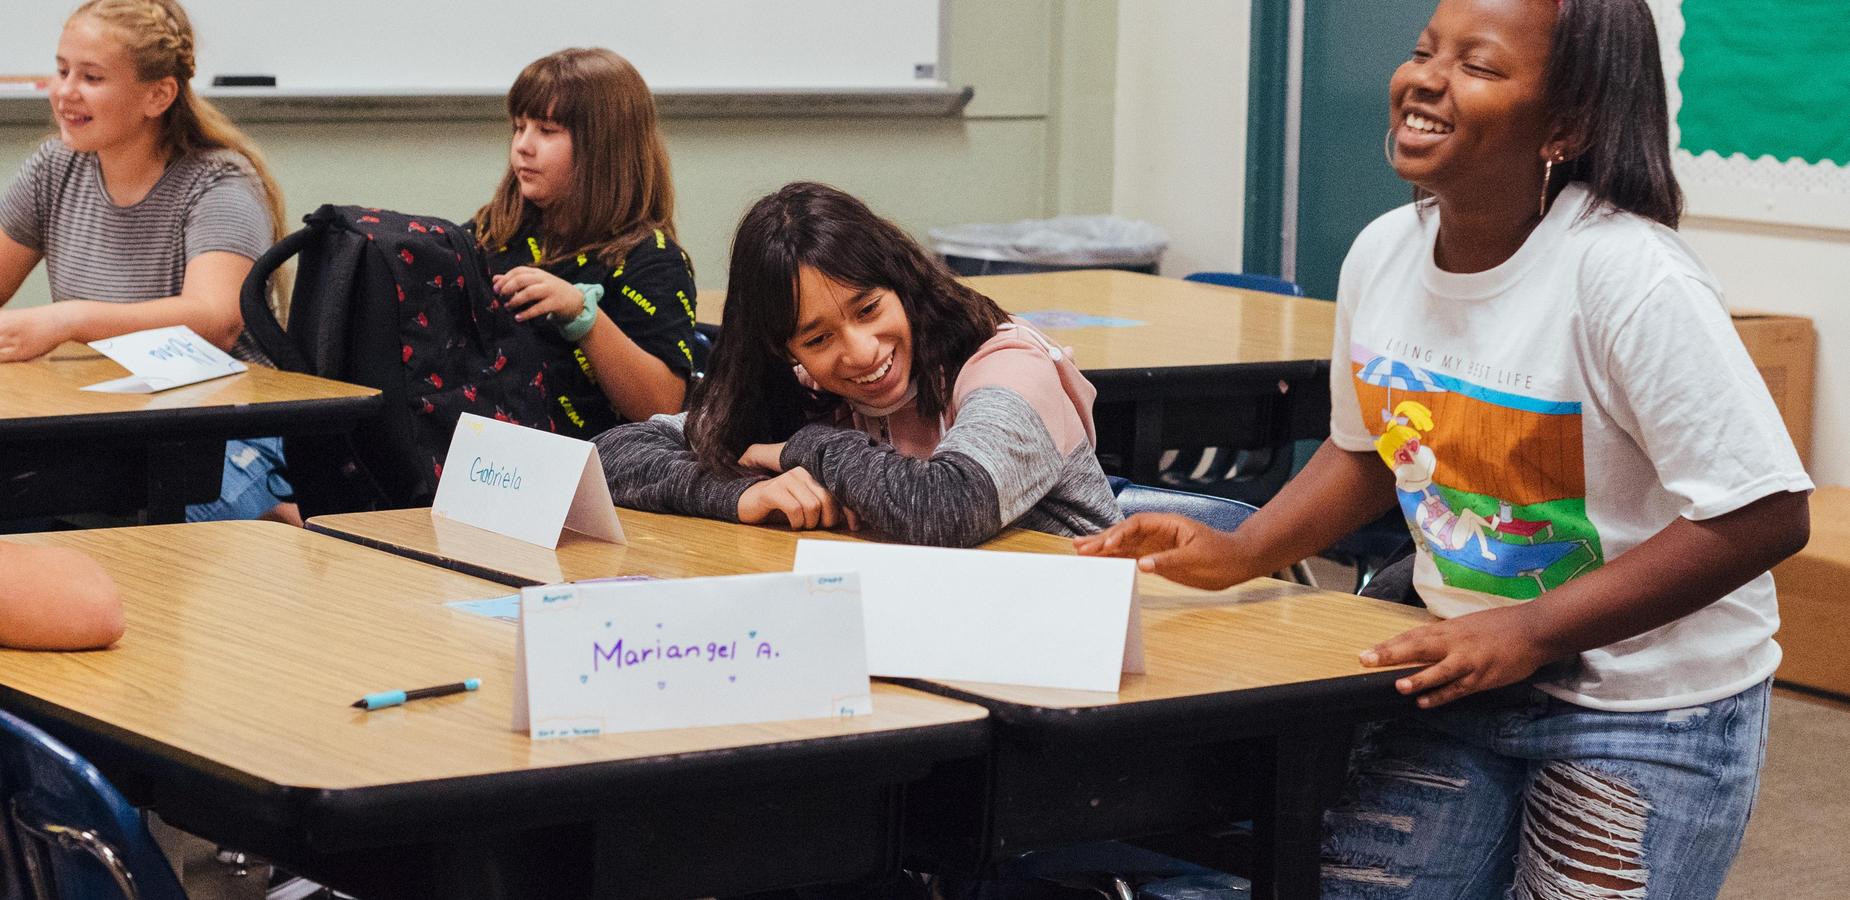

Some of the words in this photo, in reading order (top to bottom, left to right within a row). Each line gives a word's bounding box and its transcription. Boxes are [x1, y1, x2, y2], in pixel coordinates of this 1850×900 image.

[621, 284, 657, 317] KARMA
[1441, 354, 1464, 370] MY
[1497, 369, 1533, 389] LIFE
[469, 456, 522, 490] Gabriela
[592, 638, 737, 672] Mariangel
[755, 641, 780, 659] A.
